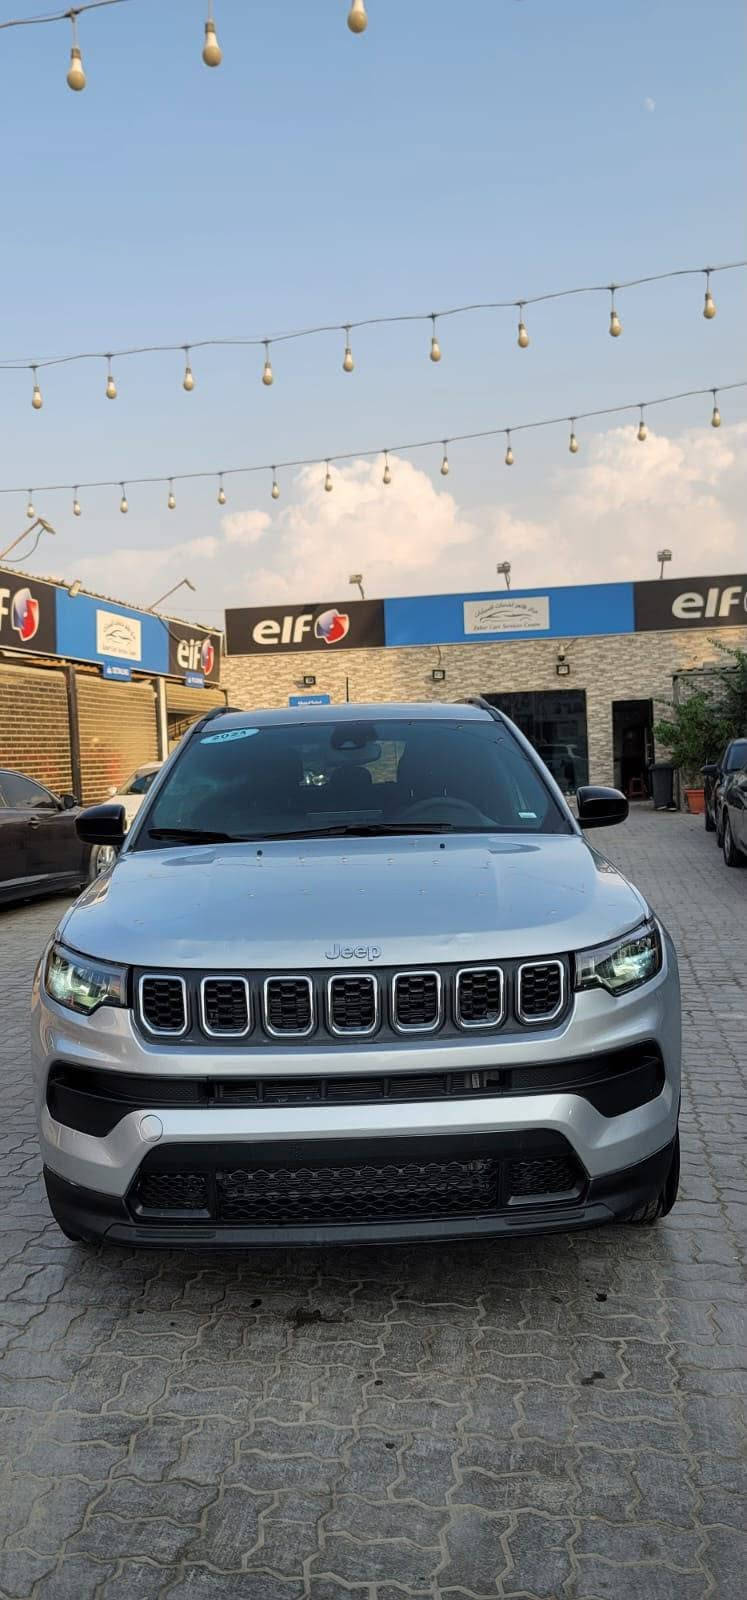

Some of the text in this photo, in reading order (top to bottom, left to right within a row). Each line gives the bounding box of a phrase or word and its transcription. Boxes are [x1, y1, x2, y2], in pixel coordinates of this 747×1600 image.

[672, 586, 743, 619] elf
[252, 614, 313, 645] elf
[177, 639, 202, 670] elf
[325, 943, 381, 961] Jeep
